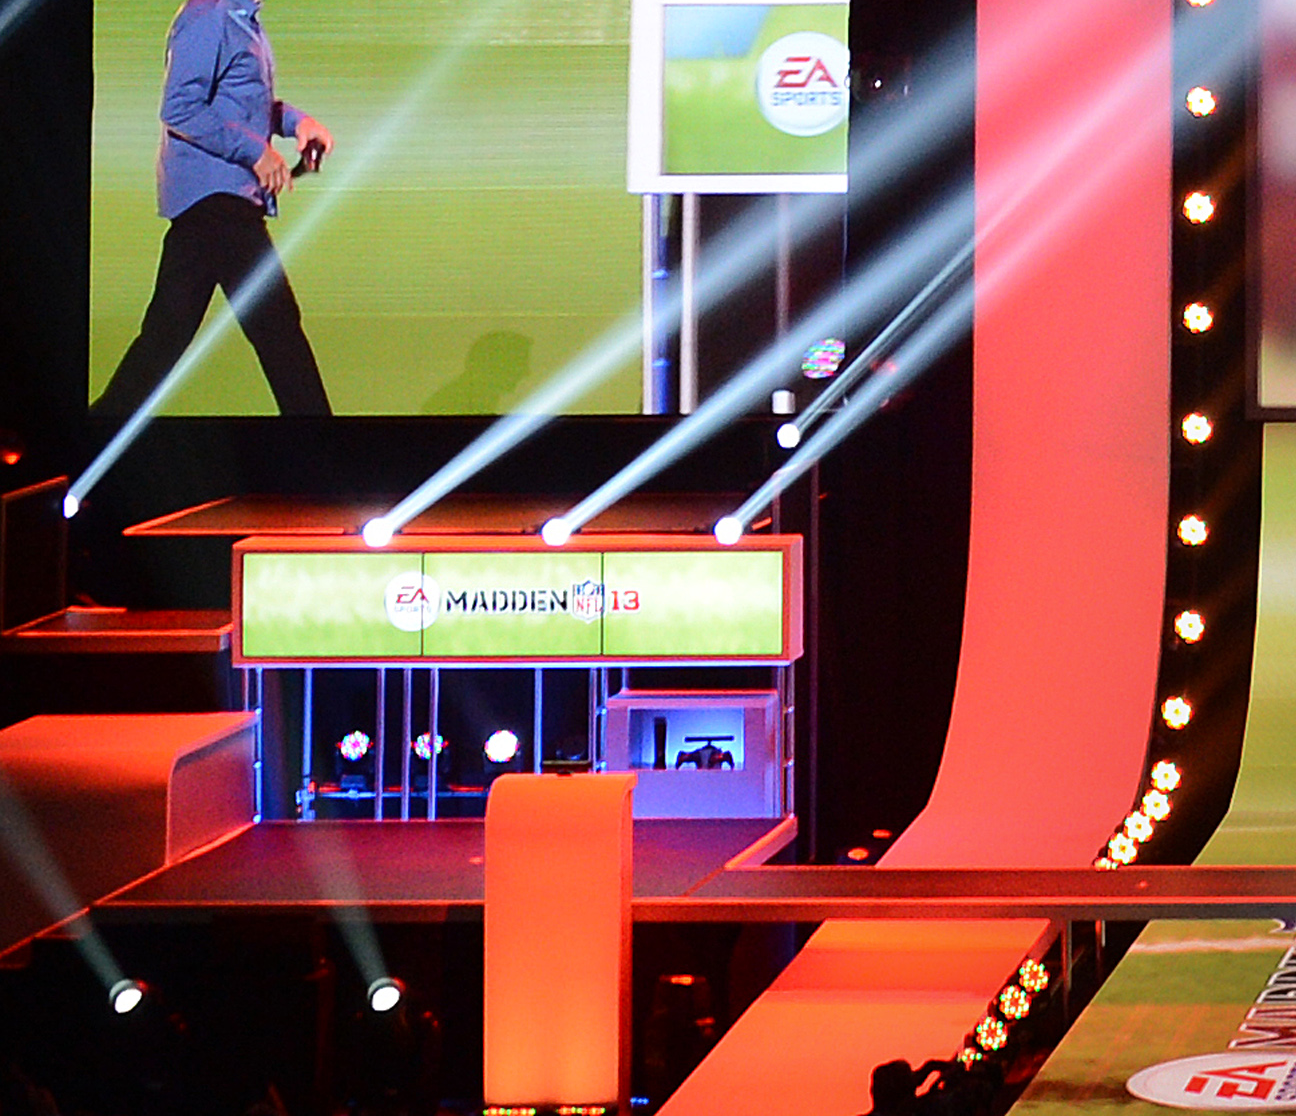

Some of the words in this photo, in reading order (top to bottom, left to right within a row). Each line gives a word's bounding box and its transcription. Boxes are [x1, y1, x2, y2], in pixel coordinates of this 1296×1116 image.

[774, 56, 838, 88] EA
[771, 90, 842, 106] SPORTS
[396, 586, 430, 604] EA
[446, 590, 568, 612] MADDEN
[611, 590, 640, 611] 13
[1184, 1060, 1289, 1101] EA
